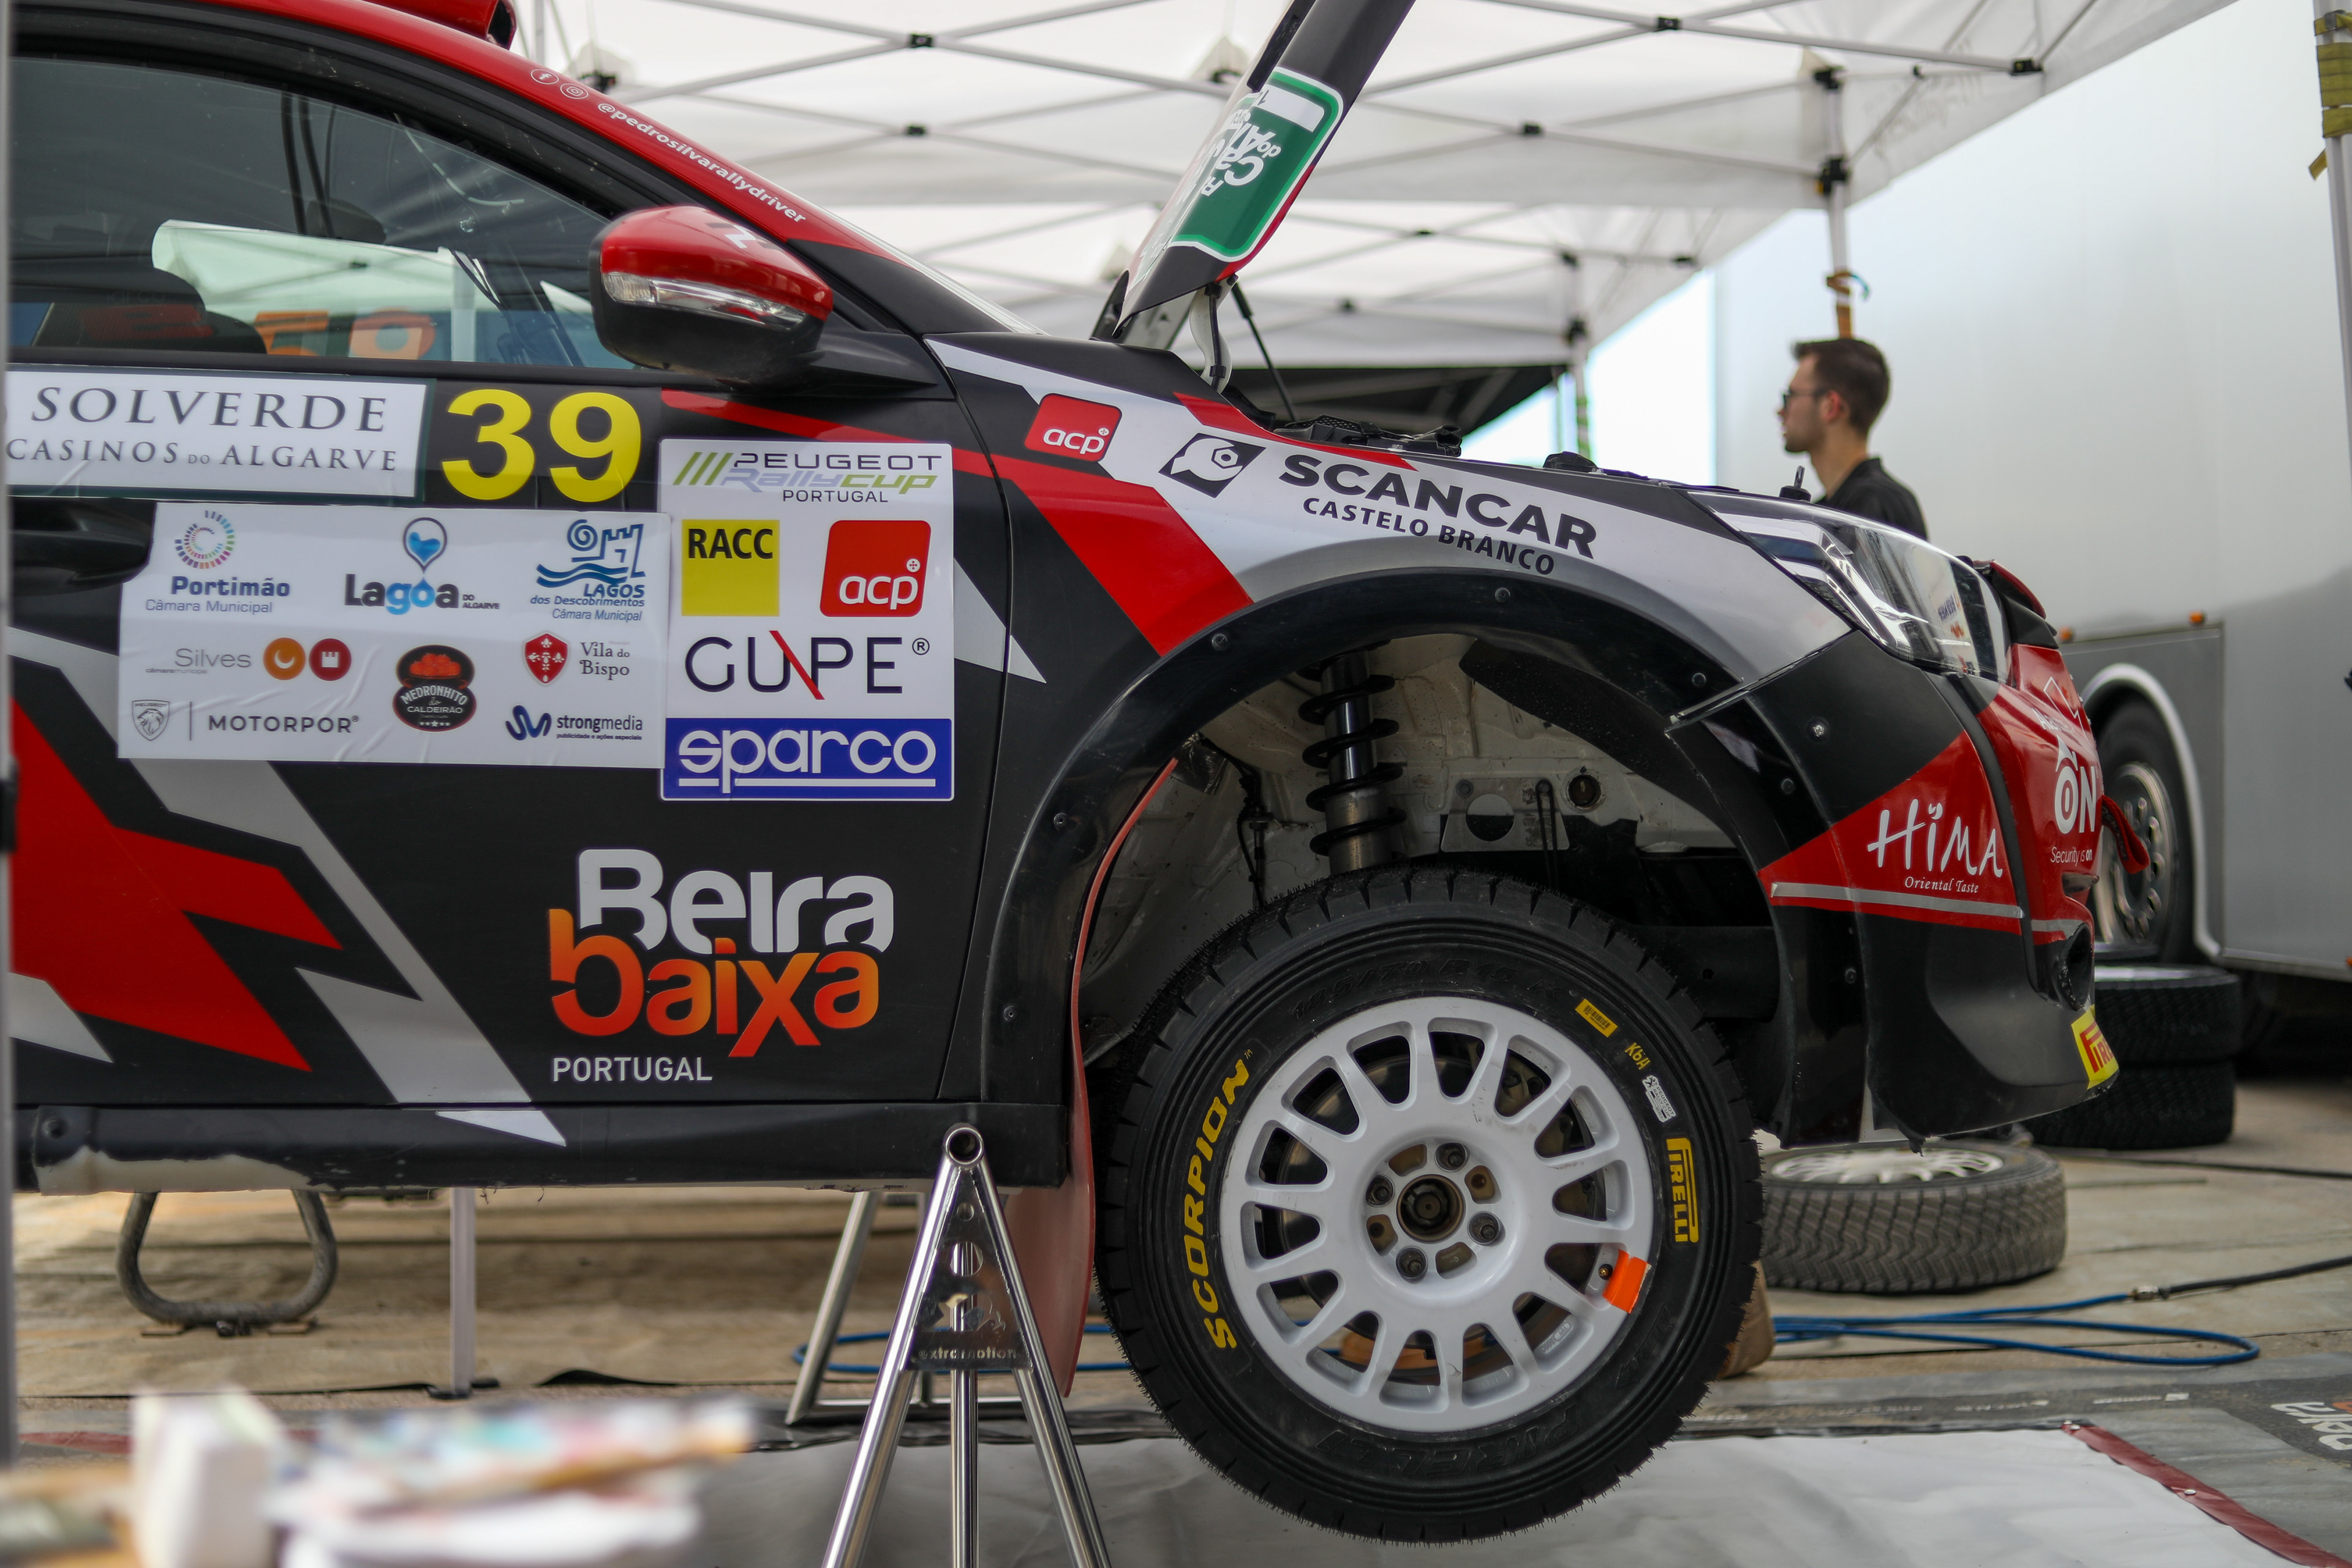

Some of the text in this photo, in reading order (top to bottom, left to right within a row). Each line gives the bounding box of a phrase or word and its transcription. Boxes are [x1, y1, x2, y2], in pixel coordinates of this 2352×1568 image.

[598, 102, 807, 224] @pedrosilvarallydriver
[31, 386, 386, 432] SOLVERDE
[5, 437, 397, 471] CASINOS DO ALGARVE
[441, 388, 642, 502] 39
[1043, 427, 1104, 455] acp
[734, 453, 942, 470] PEUGEOT
[783, 489, 889, 503] PORTUGAL
[1278, 453, 1597, 559] SCANCAR
[688, 528, 774, 560] RACC
[1302, 497, 1555, 575] CASTELO BRANCO
[171, 576, 290, 597] Portimão
[344, 573, 459, 616] Lagoa
[583, 583, 646, 598] LAGOS
[839, 574, 919, 611] acp
[146, 599, 273, 615] Câmara Municipal
[530, 595, 645, 607] dos Descobrimentos
[552, 608, 643, 623] Câmara Municipal
[175, 648, 252, 668] Silves
[579, 641, 630, 658] Vila do
[579, 660, 630, 680] Bispo
[400, 684, 468, 705] MEDRONHITO
[557, 715, 643, 733] strongmedia
[679, 729, 937, 794] sparco
[2051, 846, 2080, 867] Security
[1905, 876, 1979, 894] Oriental Taste
[548, 908, 879, 1057] baixa
[553, 1057, 713, 1082] PORTUGAL
[1653, 1088, 1672, 1118] RALLY CUP
[1655, 1086, 1675, 1116] PEUGEOT
[1666, 1137, 1699, 1243] PIRELLI
